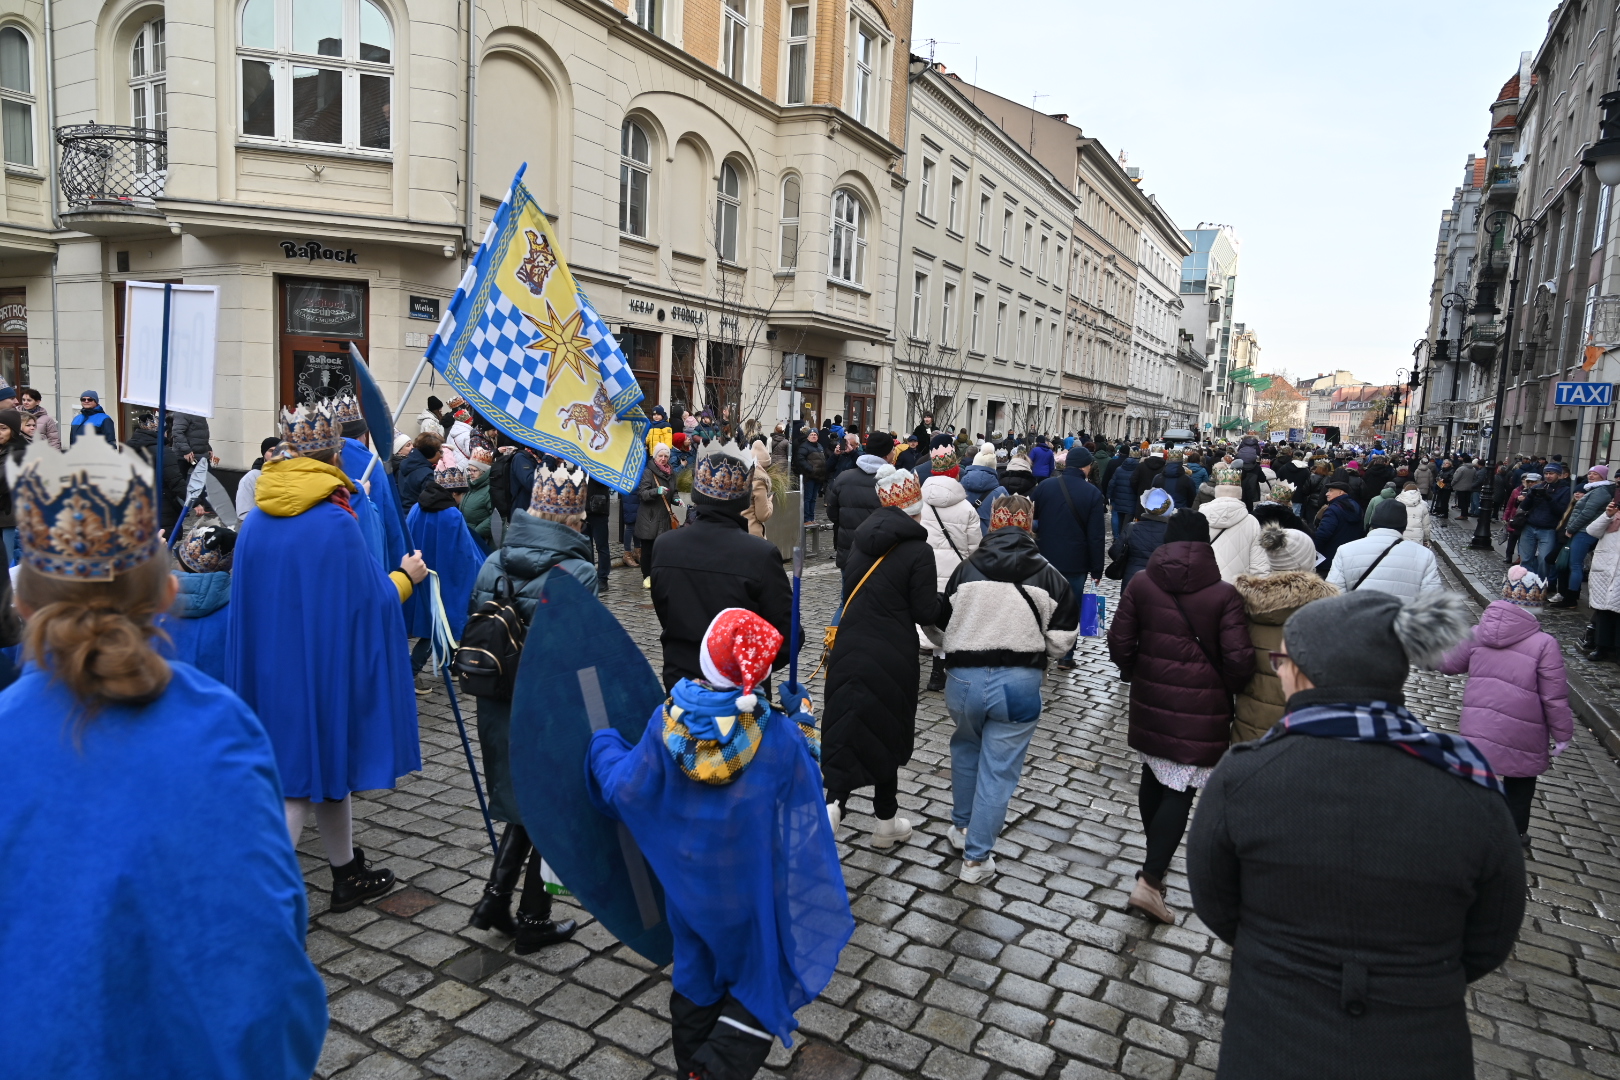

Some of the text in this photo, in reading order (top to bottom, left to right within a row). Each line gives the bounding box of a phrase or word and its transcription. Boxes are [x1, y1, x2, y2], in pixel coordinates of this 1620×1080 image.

[280, 241, 358, 264] BaRock
[414, 303, 434, 313] Wielka
[629, 299, 655, 314] KEBAP
[307, 355, 343, 365] BaRock
[1559, 385, 1610, 403] TAXI
